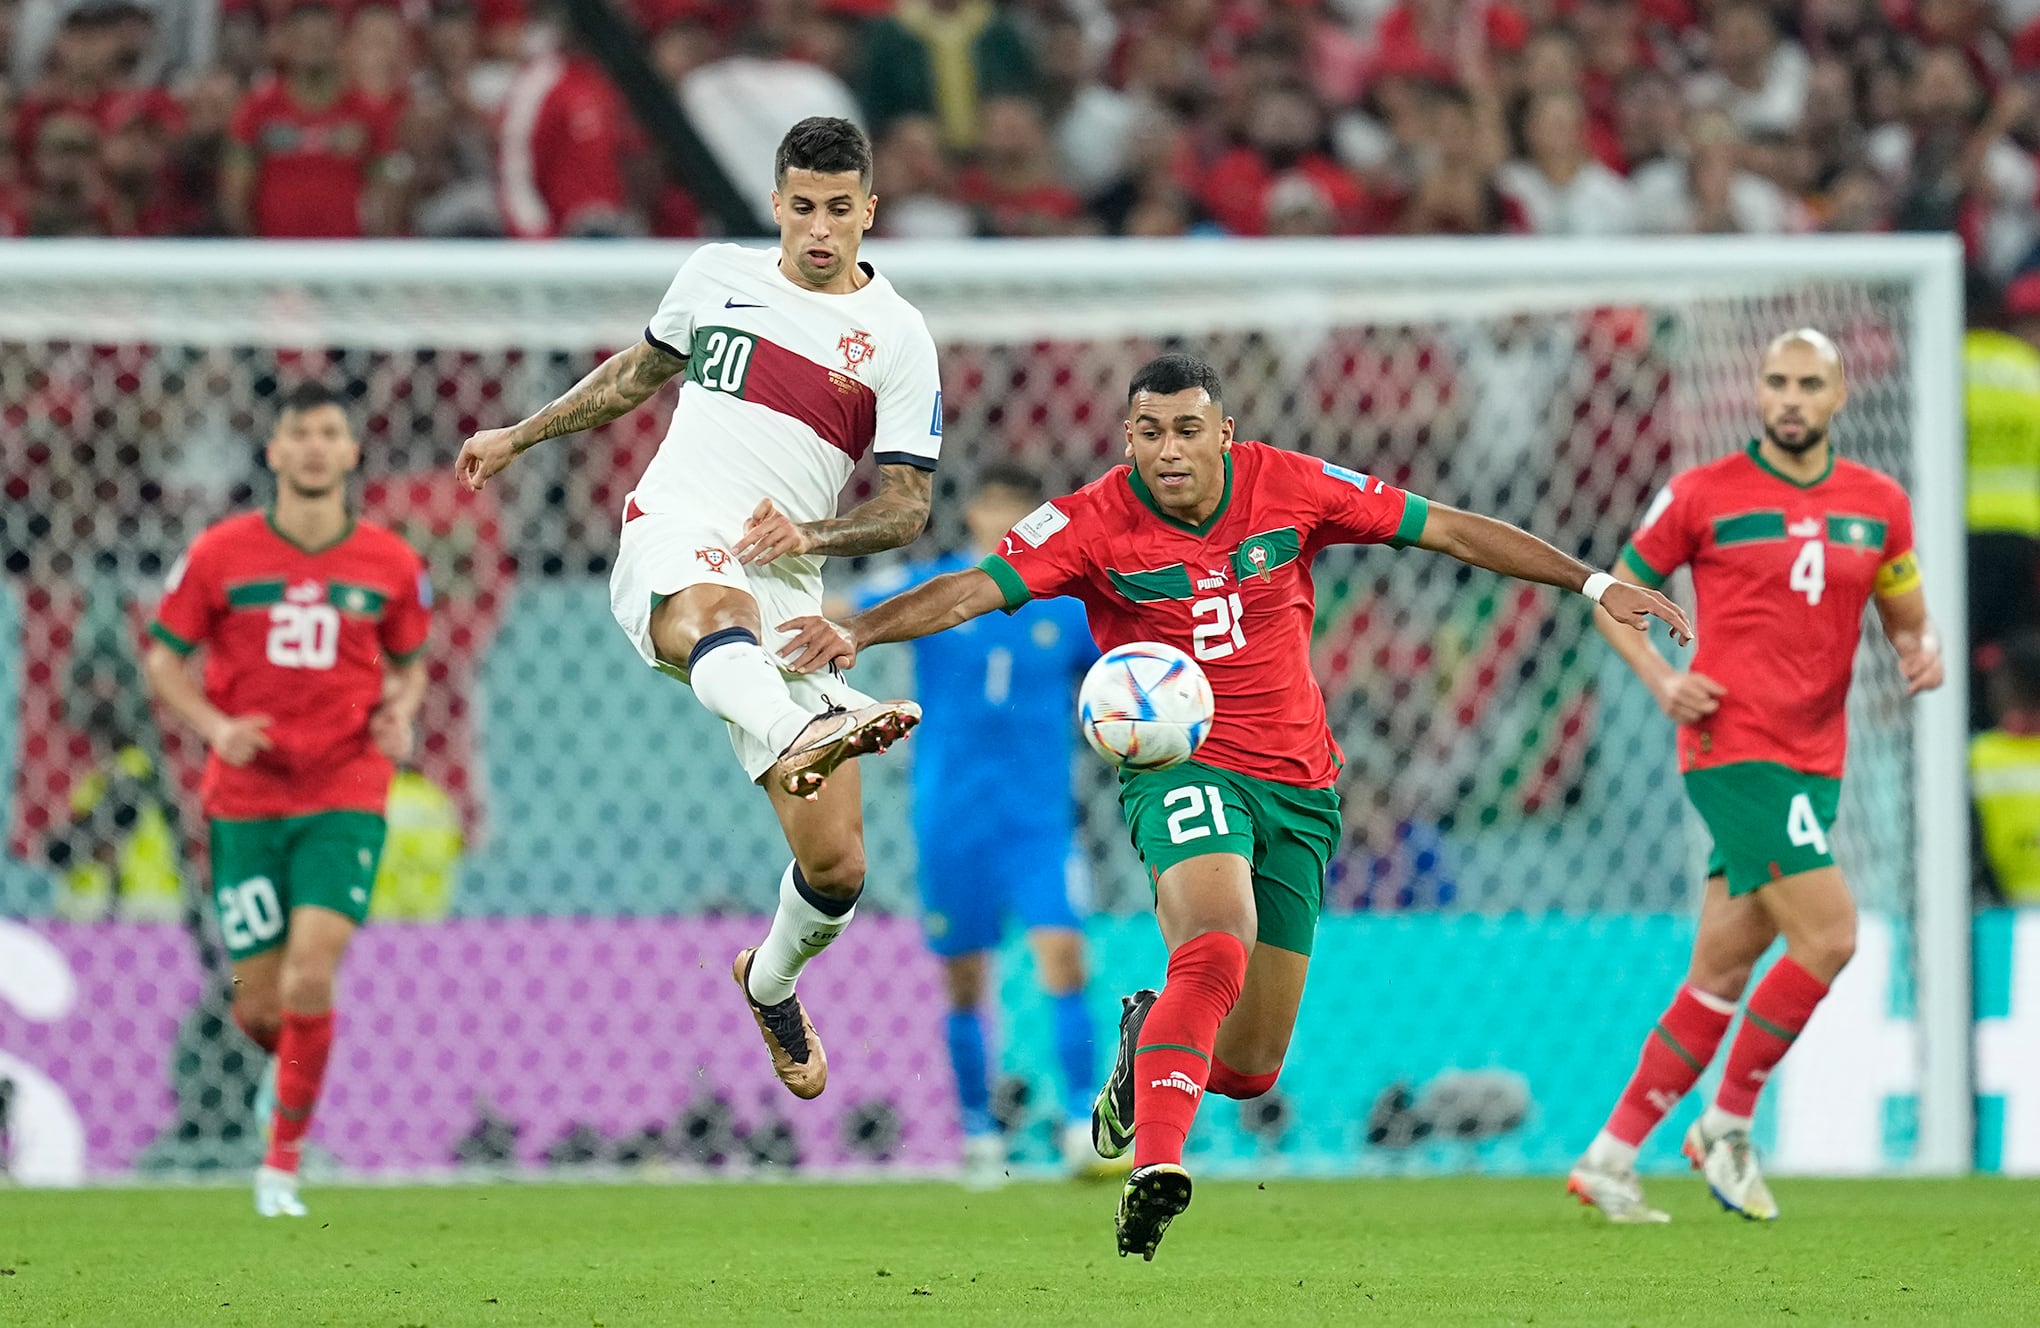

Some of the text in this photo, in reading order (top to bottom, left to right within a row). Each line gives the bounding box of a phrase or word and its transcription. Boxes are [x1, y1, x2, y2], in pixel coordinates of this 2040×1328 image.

[703, 331, 753, 393] 20
[1197, 577, 1225, 591] PUMA
[1790, 539, 1826, 606] 4
[266, 603, 341, 670] 20
[1192, 592, 1248, 661] 21
[985, 645, 1013, 704] 1
[1163, 785, 1230, 844] 21
[1787, 792, 1828, 855] 4
[218, 875, 284, 949] 20
[1151, 1077, 1195, 1096] PUMA
